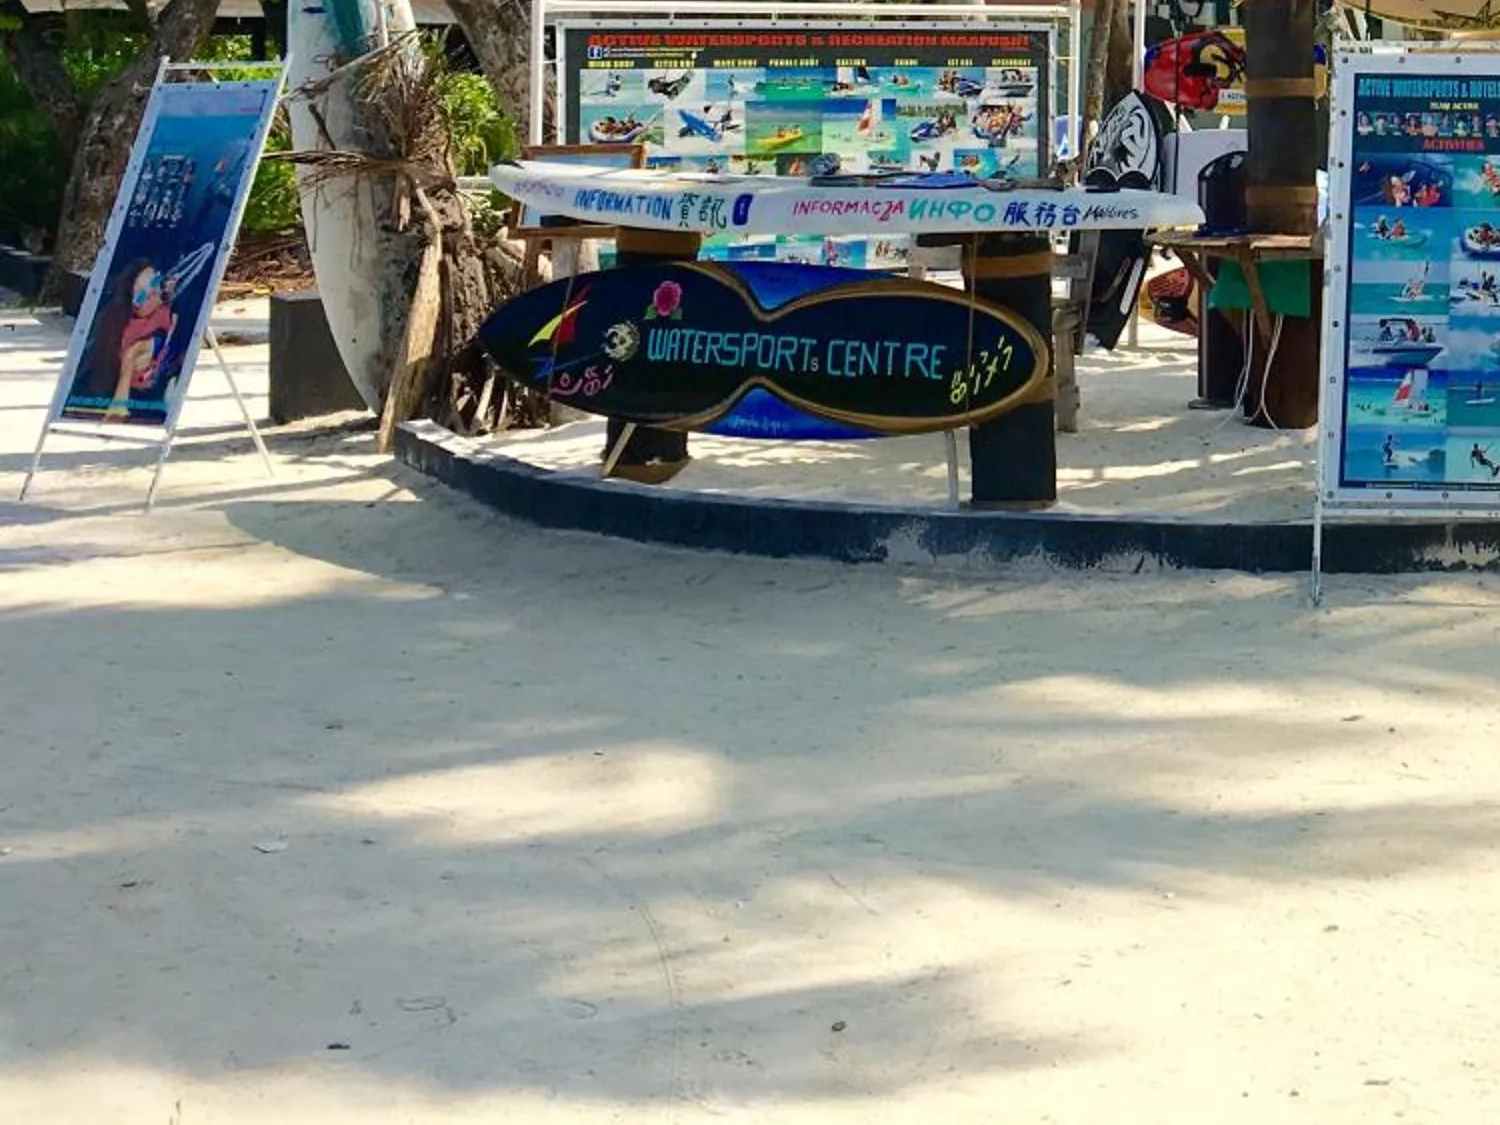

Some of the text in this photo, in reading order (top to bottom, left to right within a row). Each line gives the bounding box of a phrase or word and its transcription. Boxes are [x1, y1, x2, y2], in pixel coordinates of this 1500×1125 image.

[574, 188, 673, 221] INFORMATION
[909, 199, 995, 223] ИНФО
[827, 339, 947, 380] CENTRE
